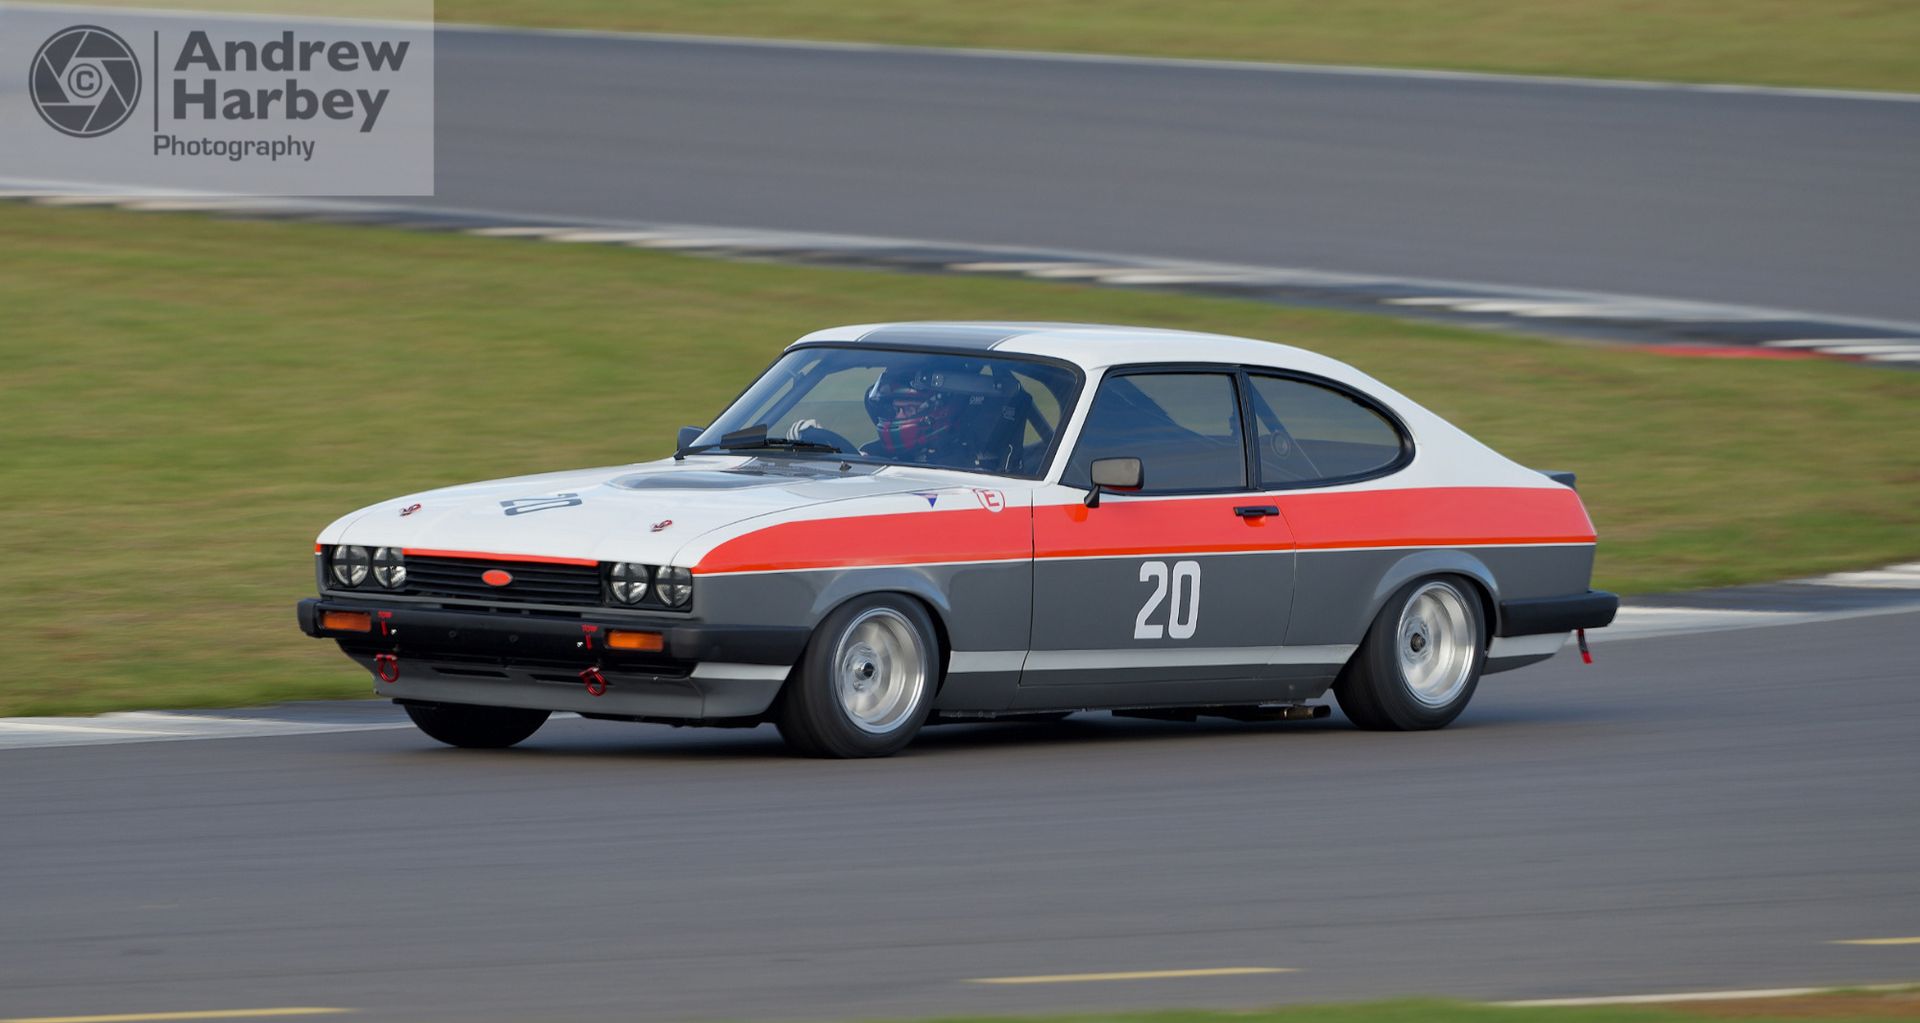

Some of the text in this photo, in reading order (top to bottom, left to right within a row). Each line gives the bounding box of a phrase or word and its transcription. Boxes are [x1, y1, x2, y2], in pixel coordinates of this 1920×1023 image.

[500, 493, 582, 516] 20
[983, 490, 1000, 507] E
[1134, 561, 1201, 639] 20
